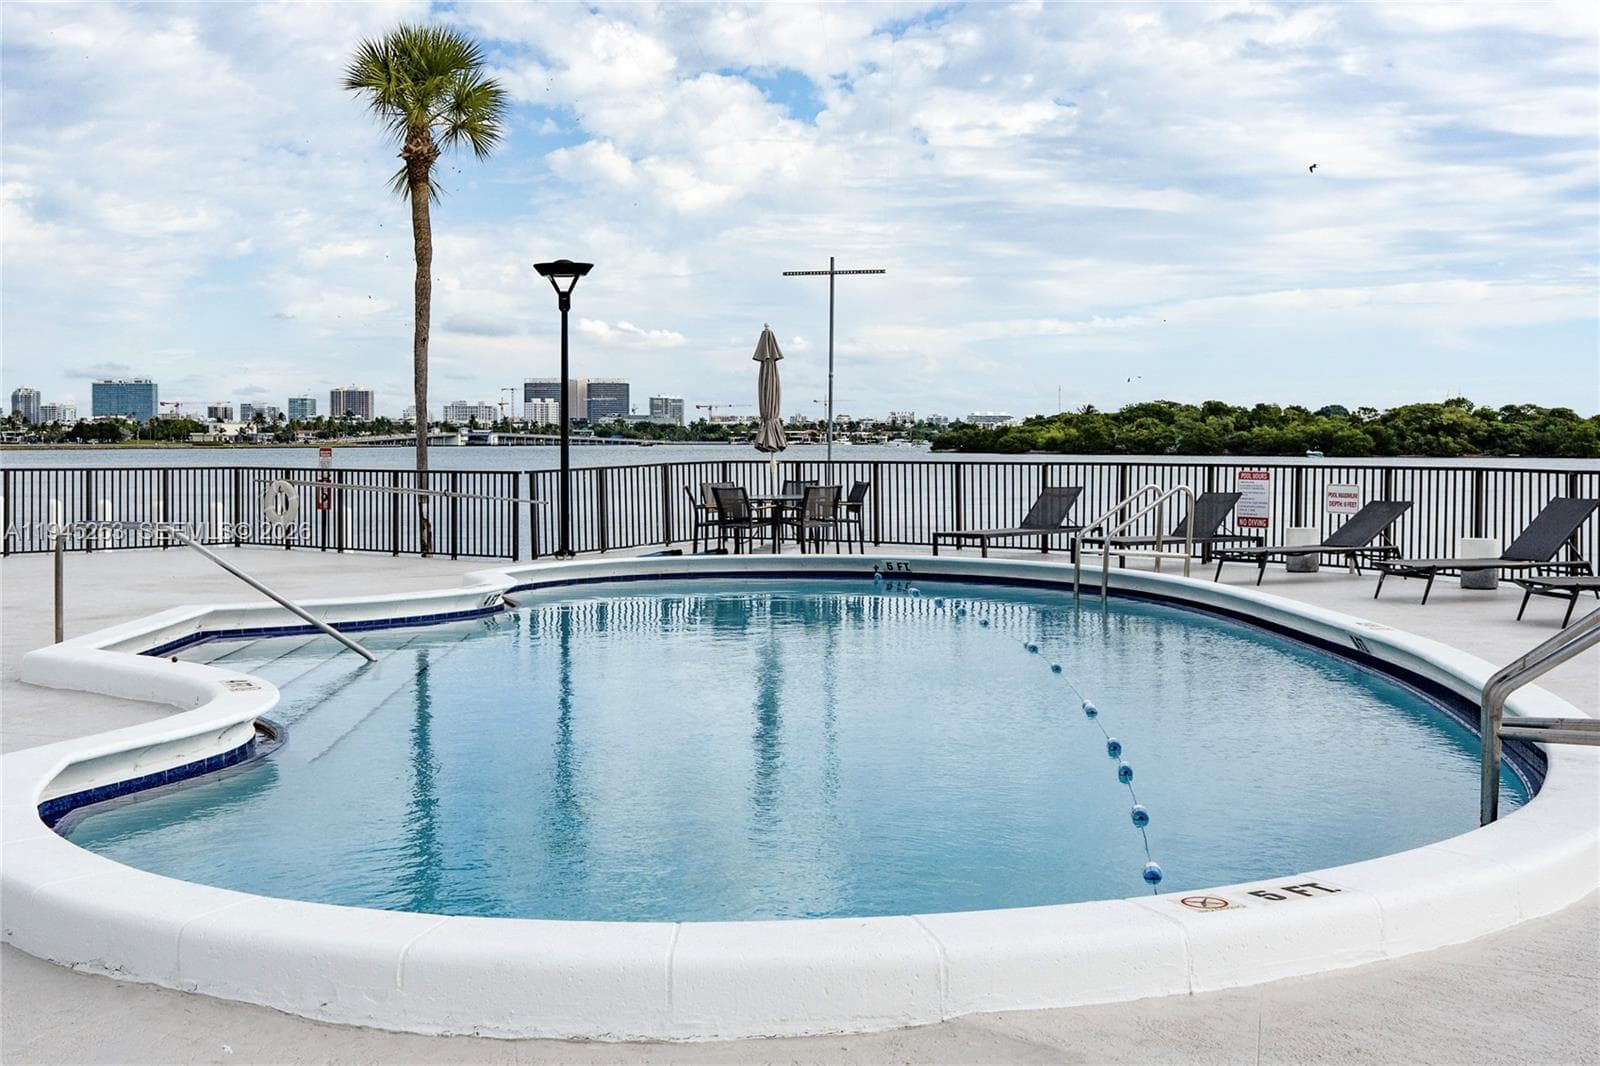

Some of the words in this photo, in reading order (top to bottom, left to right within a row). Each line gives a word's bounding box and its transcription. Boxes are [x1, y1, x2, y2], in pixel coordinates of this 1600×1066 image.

[1239, 518, 1248, 526] NO
[1248, 519, 1267, 527] DIVING
[886, 562, 894, 571] 5
[1248, 890, 1287, 901] 5
